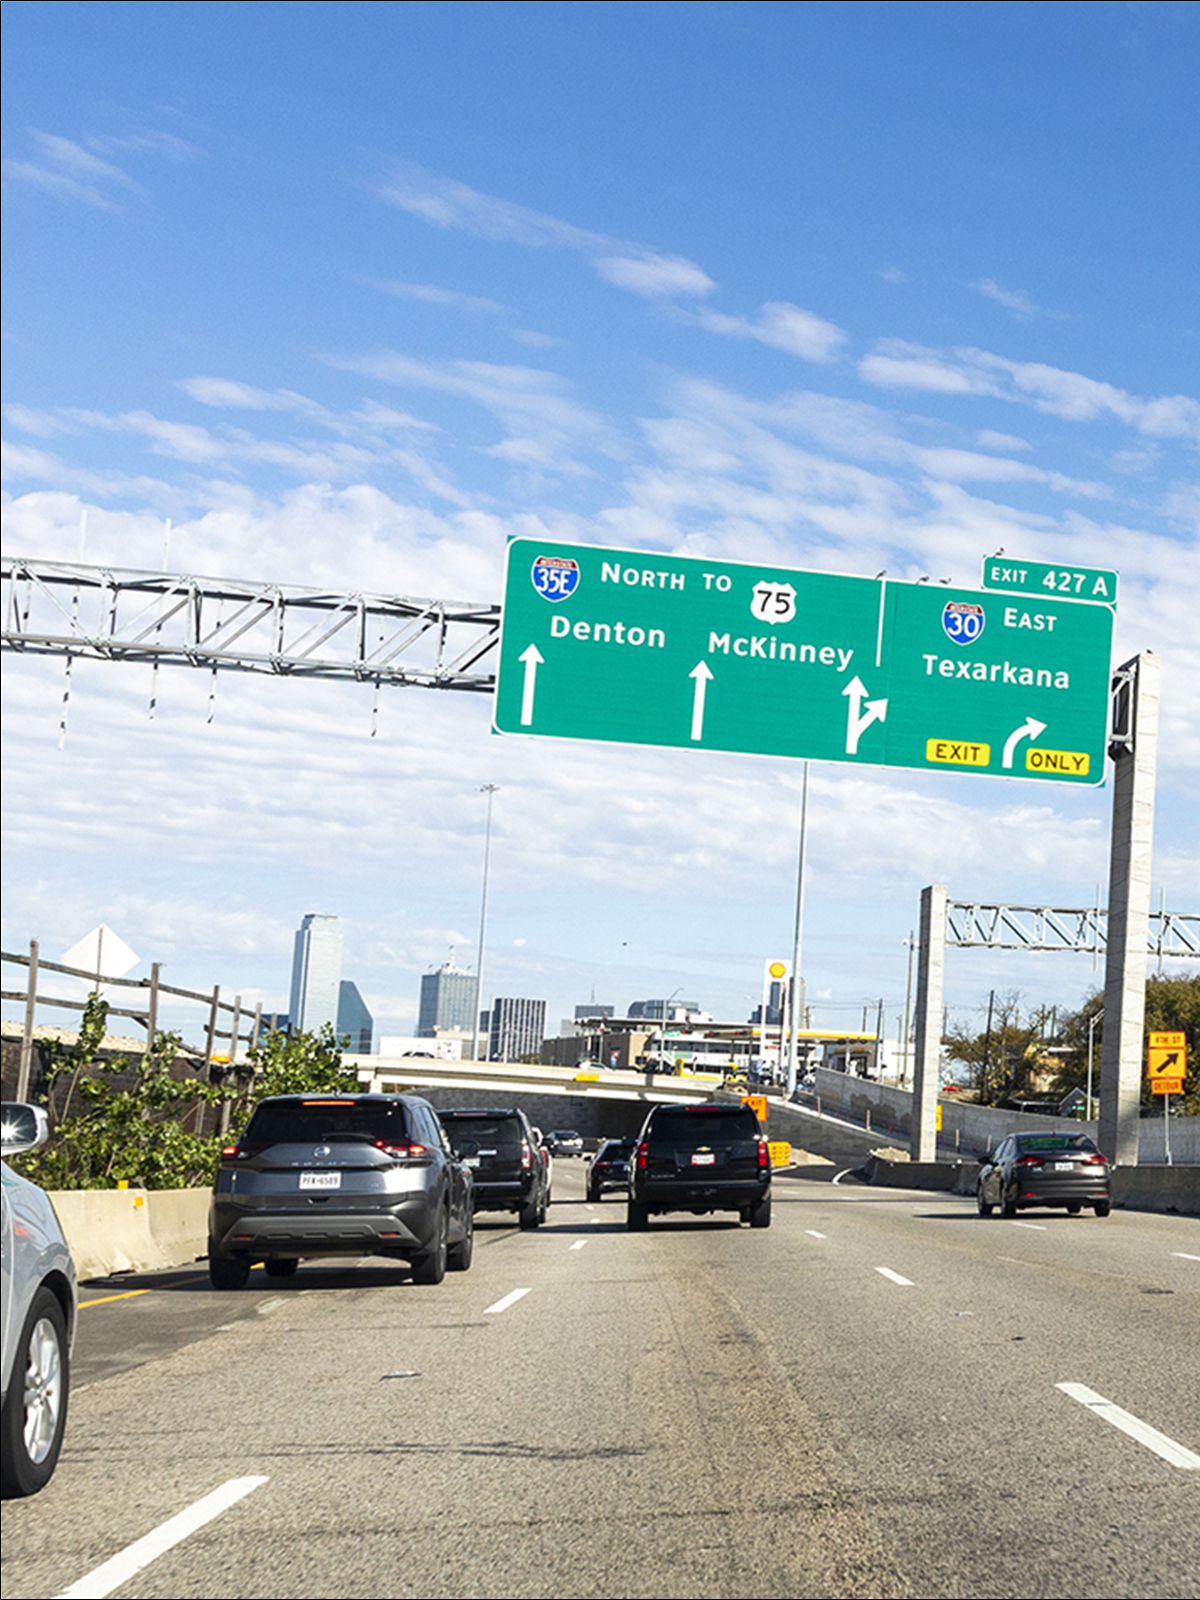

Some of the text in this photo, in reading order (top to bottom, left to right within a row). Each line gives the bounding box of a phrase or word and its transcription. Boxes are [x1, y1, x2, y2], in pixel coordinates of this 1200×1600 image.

[537, 568, 571, 594] 35E
[601, 562, 732, 592] NORTH TO
[991, 566, 1108, 597] EXIT 427 A
[757, 590, 791, 615] 75
[551, 615, 665, 648] Denton
[948, 612, 980, 637] 30
[1003, 607, 1058, 632] EAST
[708, 631, 854, 672] McKinney
[922, 654, 1069, 689] Texarkana
[936, 743, 980, 761] EXIT
[1030, 752, 1085, 771] ONLY
